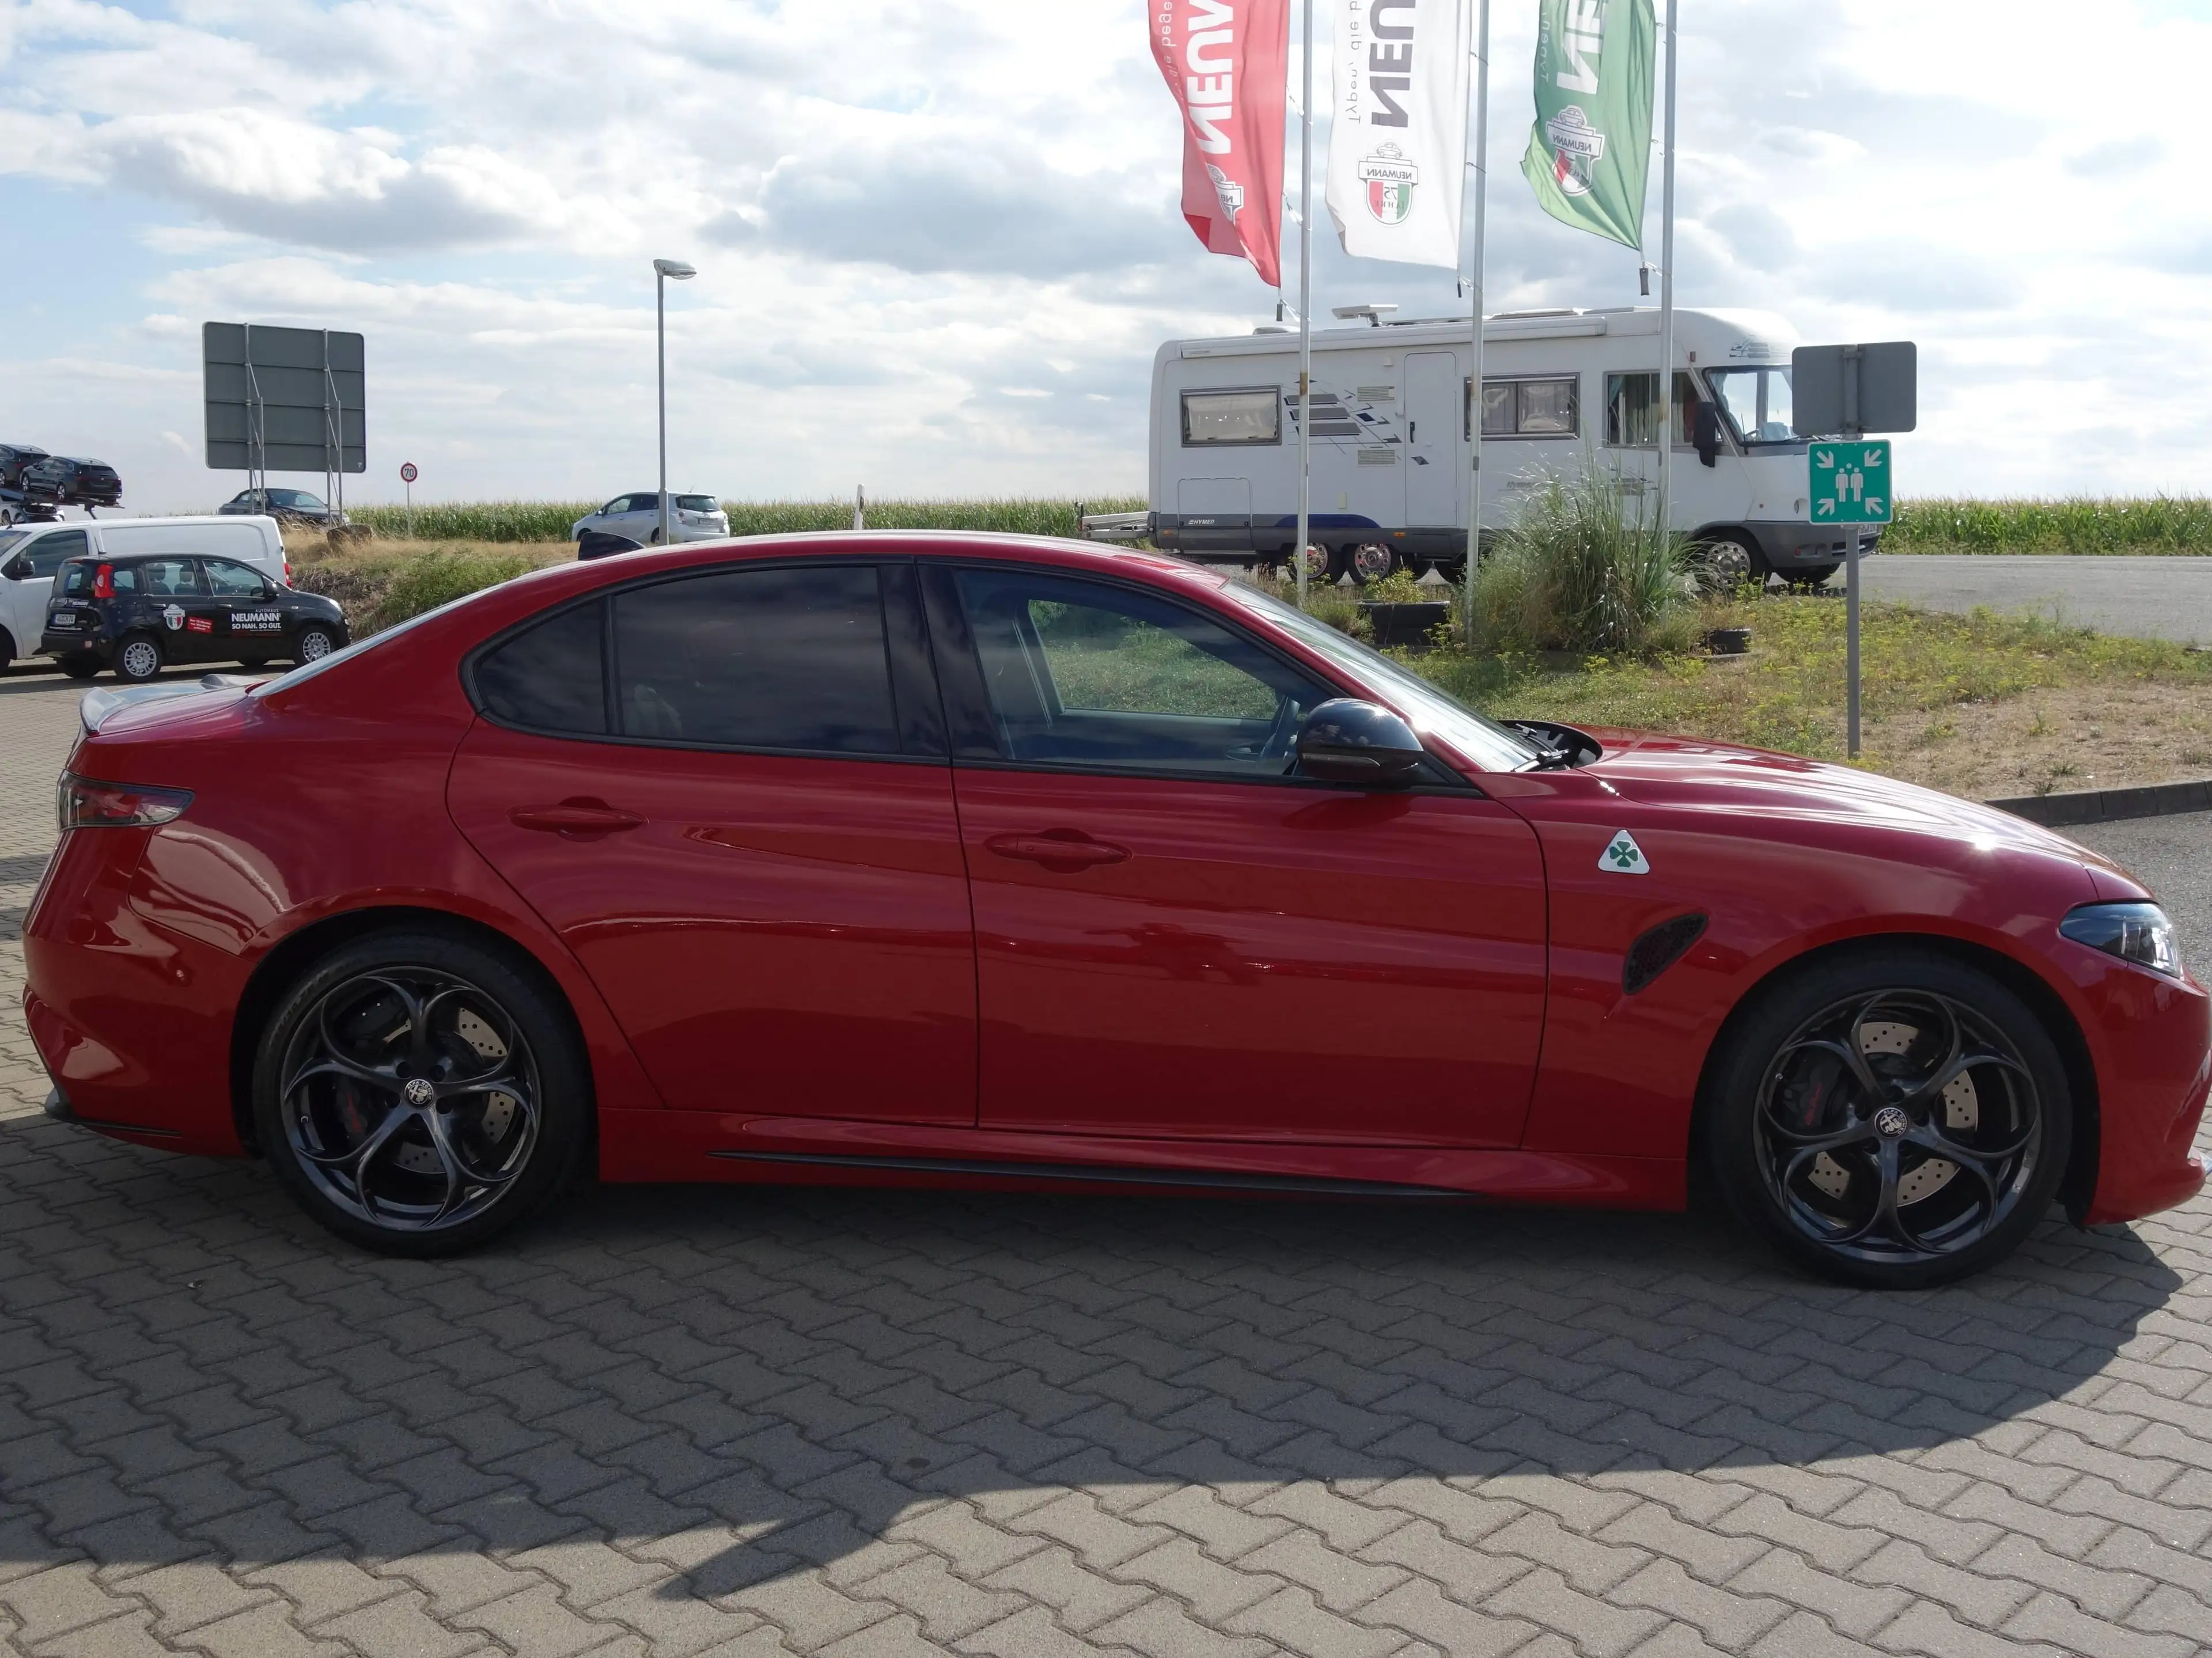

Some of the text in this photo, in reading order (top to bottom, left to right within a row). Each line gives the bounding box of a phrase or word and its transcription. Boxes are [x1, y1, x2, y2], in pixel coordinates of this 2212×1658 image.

[404, 468, 414, 477] 70
[231, 612, 280, 622] NEUMANN
[407, 1080, 432, 1101] ALFA ROMEO
